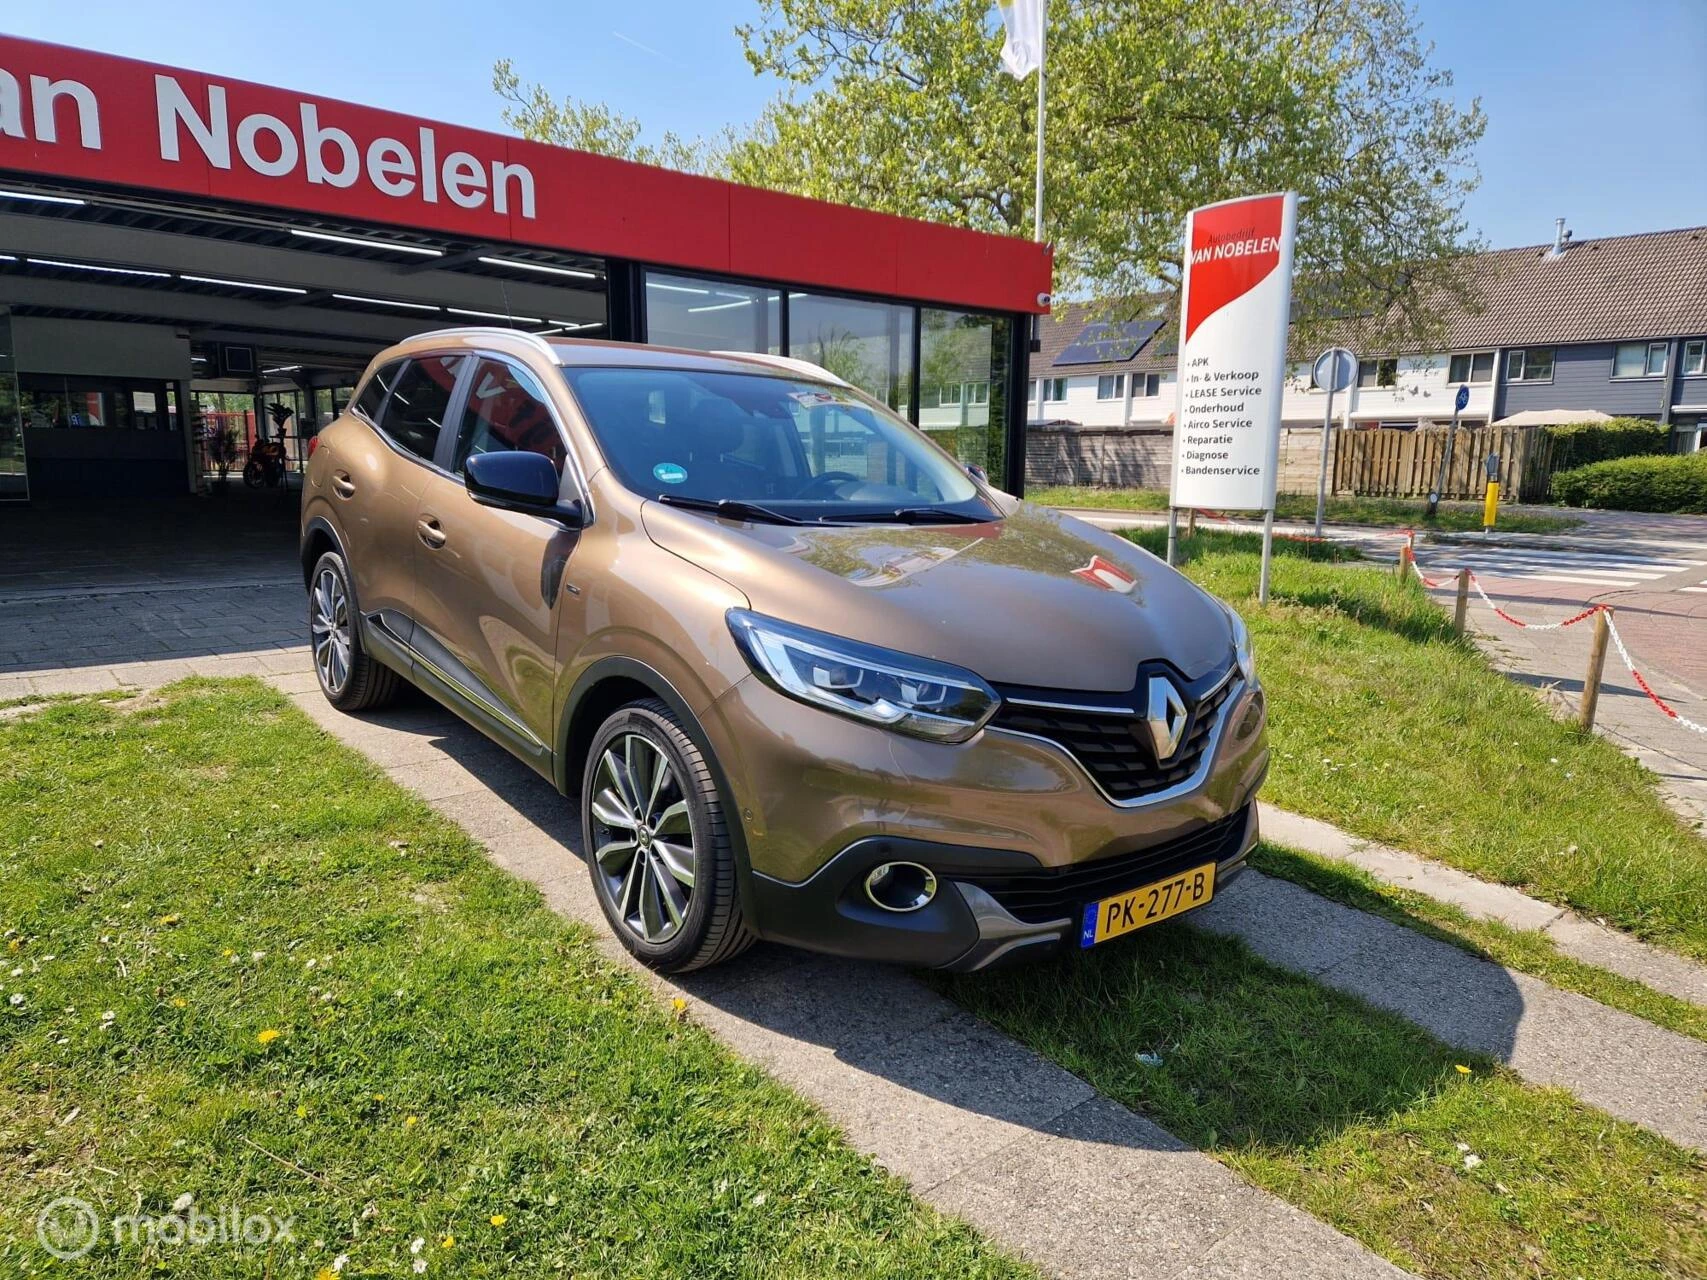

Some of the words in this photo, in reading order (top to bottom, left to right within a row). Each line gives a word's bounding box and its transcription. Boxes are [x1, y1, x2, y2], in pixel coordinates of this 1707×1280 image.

[155, 74, 536, 219] Nobelen
[1208, 226, 1256, 244] Autobedrijf
[1190, 246, 1213, 264] VAN
[1214, 236, 1281, 260] NOBELEN
[1191, 357, 1209, 367] APK
[1204, 372, 1211, 382] &
[1214, 370, 1259, 382] Verkoop
[1190, 387, 1218, 399] LEASE
[1220, 385, 1262, 397] Service
[1189, 402, 1244, 414] Onderhoud
[1188, 420, 1210, 430] Airco
[1212, 417, 1253, 428] Service
[1187, 434, 1233, 446] Reparatie
[1186, 450, 1229, 462] Diagnose
[1185, 465, 1260, 475] Bandenservice
[1106, 872, 1205, 933] PK-277-B
[1083, 930, 1093, 939] NL
